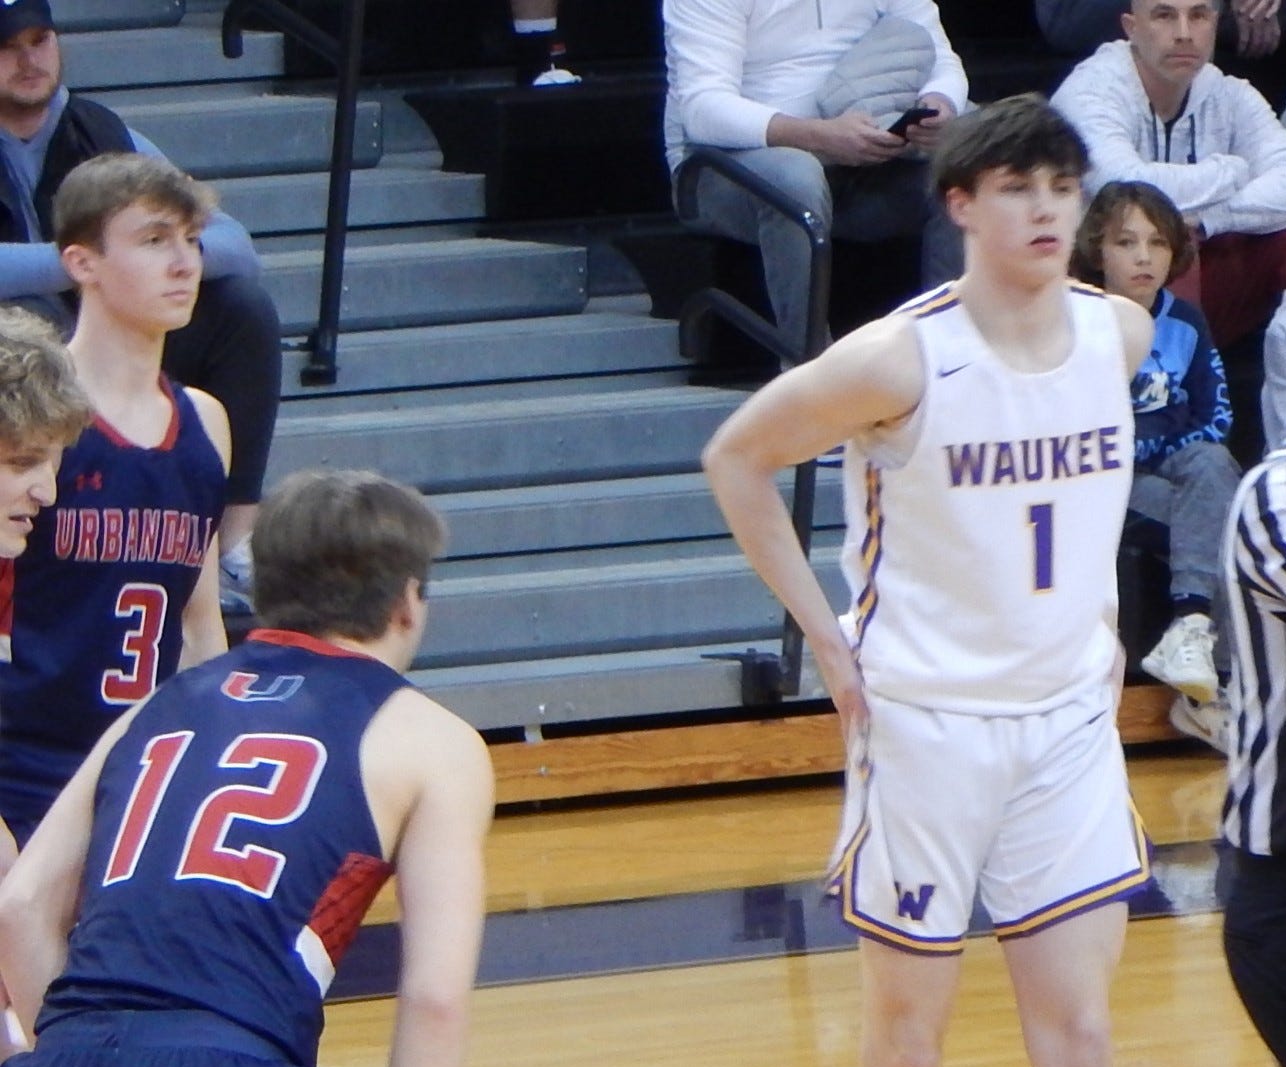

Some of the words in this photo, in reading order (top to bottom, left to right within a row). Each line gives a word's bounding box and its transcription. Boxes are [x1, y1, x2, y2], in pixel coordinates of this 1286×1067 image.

[943, 425, 1122, 488] WAUKEE
[1025, 501, 1054, 595] 1
[101, 583, 168, 704] 3
[102, 731, 328, 899] 12
[894, 881, 936, 921] W
